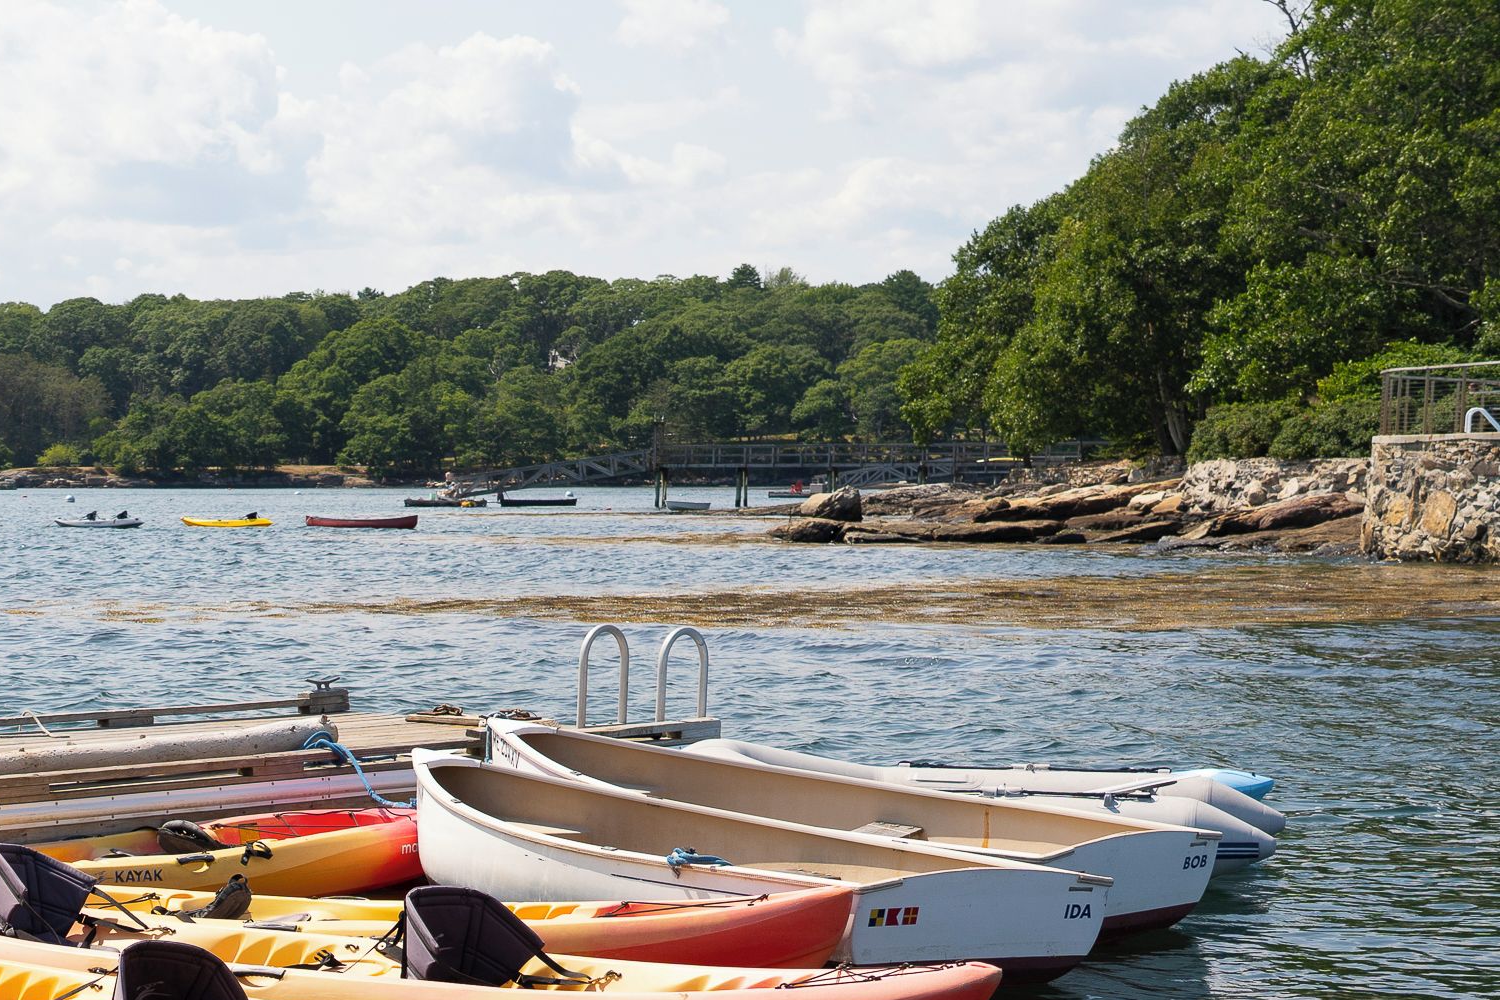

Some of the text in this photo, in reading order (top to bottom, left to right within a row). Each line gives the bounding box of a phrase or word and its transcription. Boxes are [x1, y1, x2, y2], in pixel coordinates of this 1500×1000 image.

[1182, 855, 1208, 870] BOB
[114, 868, 164, 883] KAYAK
[1063, 903, 1092, 919] IDA
